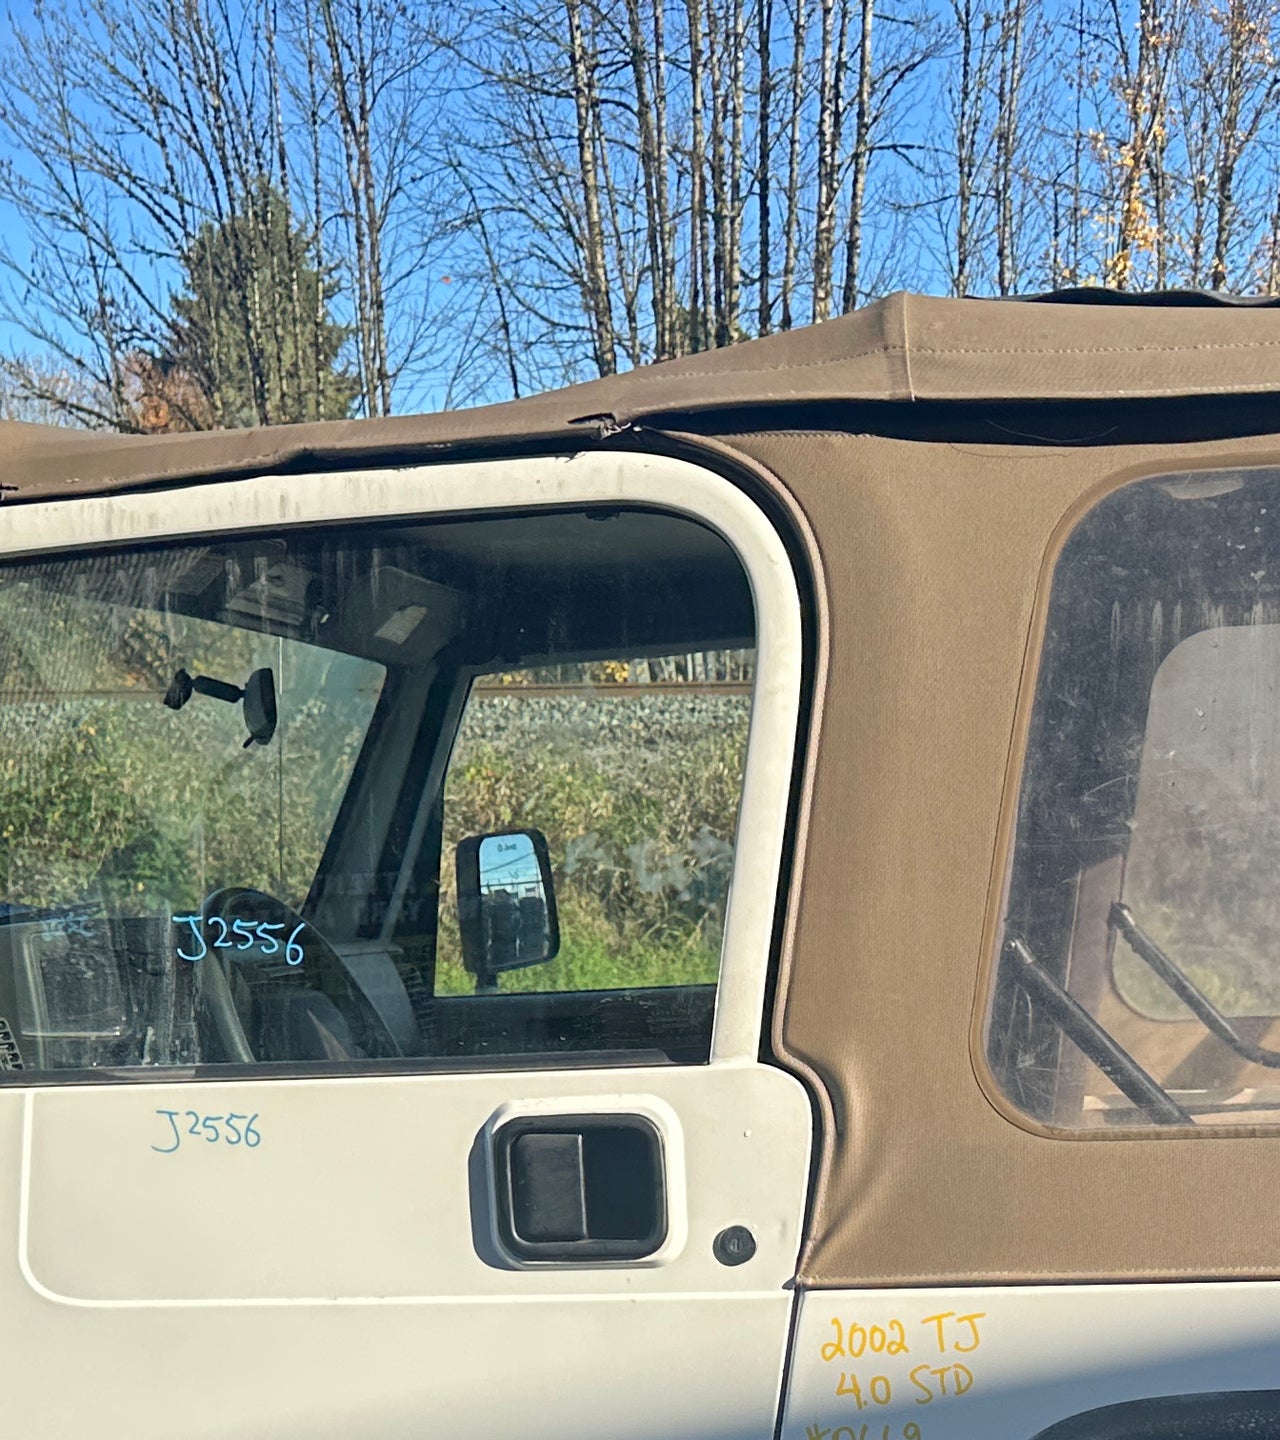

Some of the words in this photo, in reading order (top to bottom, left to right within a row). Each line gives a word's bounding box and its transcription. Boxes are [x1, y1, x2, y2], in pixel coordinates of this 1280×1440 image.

[172, 914, 306, 967] J2556
[151, 1110, 261, 1154] J2556
[821, 1317, 910, 1362] 2002
[920, 1311, 987, 1353] TJ
[836, 1371, 892, 1411] 4.0
[909, 1362, 975, 1405] STD
